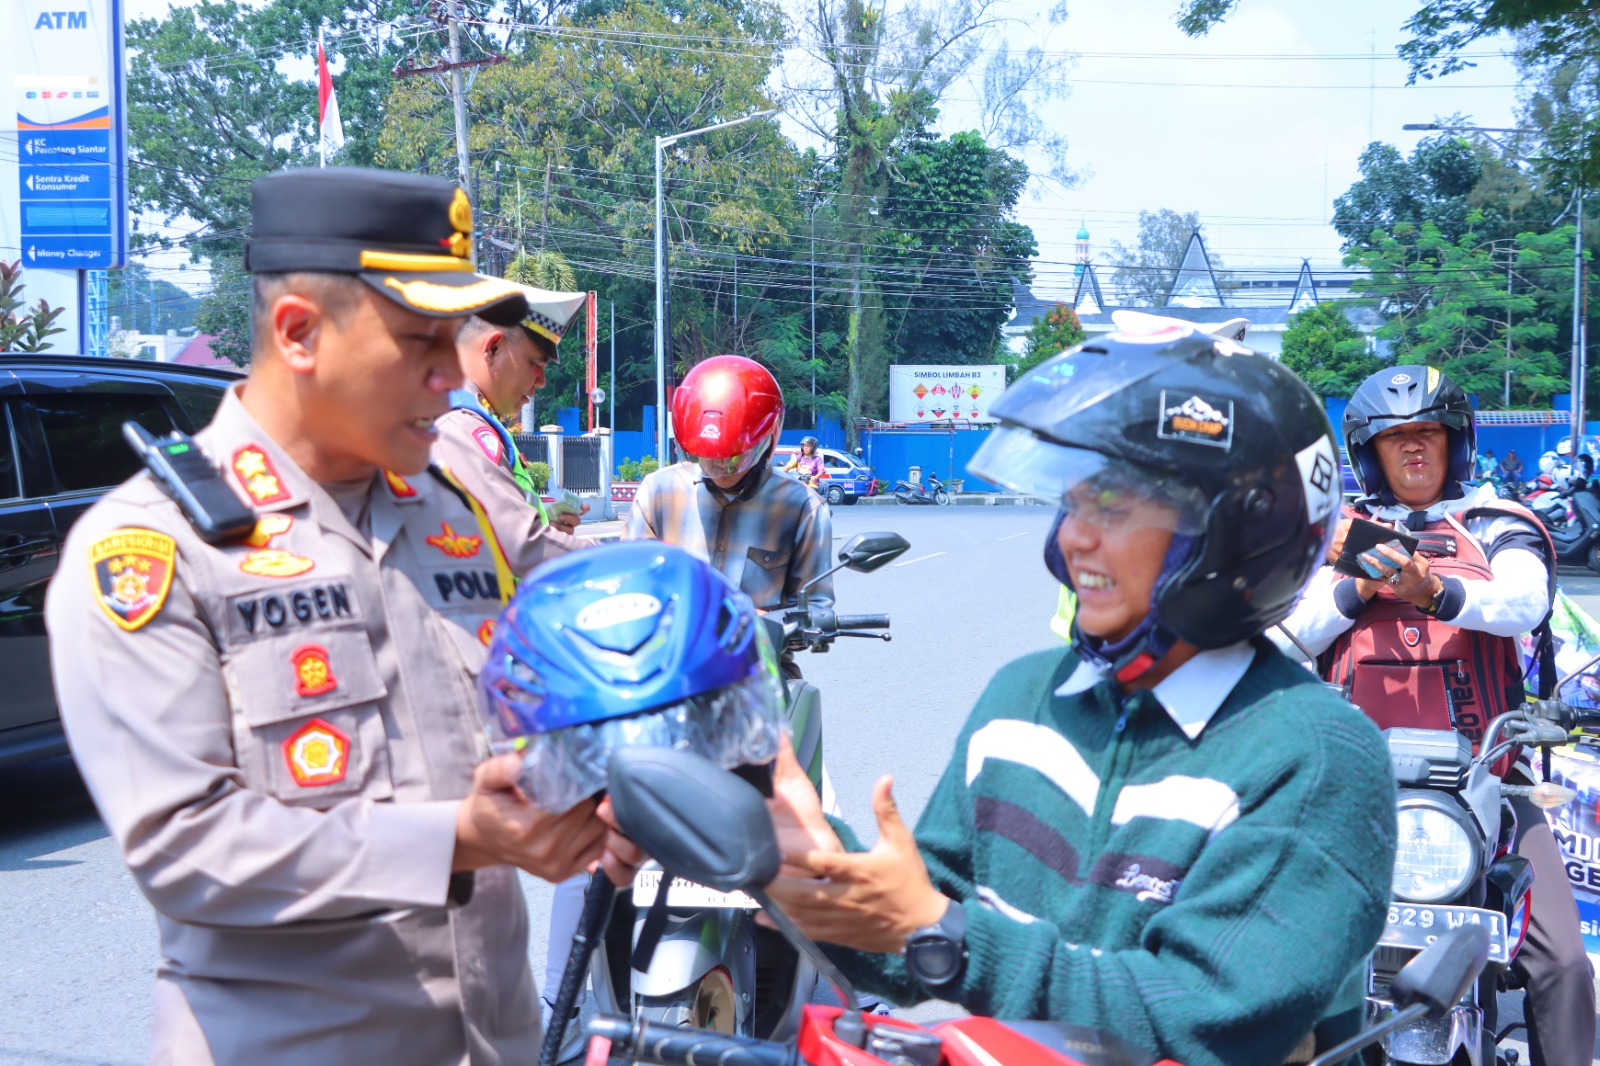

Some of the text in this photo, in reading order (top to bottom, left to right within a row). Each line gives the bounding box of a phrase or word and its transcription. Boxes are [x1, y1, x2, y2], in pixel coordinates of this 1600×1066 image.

[35, 11, 87, 30] ATM
[34, 139, 46, 147] KC
[78, 145, 107, 154] Siantar
[35, 174, 90, 183] Sentra Kredit
[35, 182, 77, 191] Konsumer
[37, 249, 101, 258] Money Changer
[914, 371, 981, 379] SIMBOL LIMBAH B3
[237, 584, 352, 633] YOGEN
